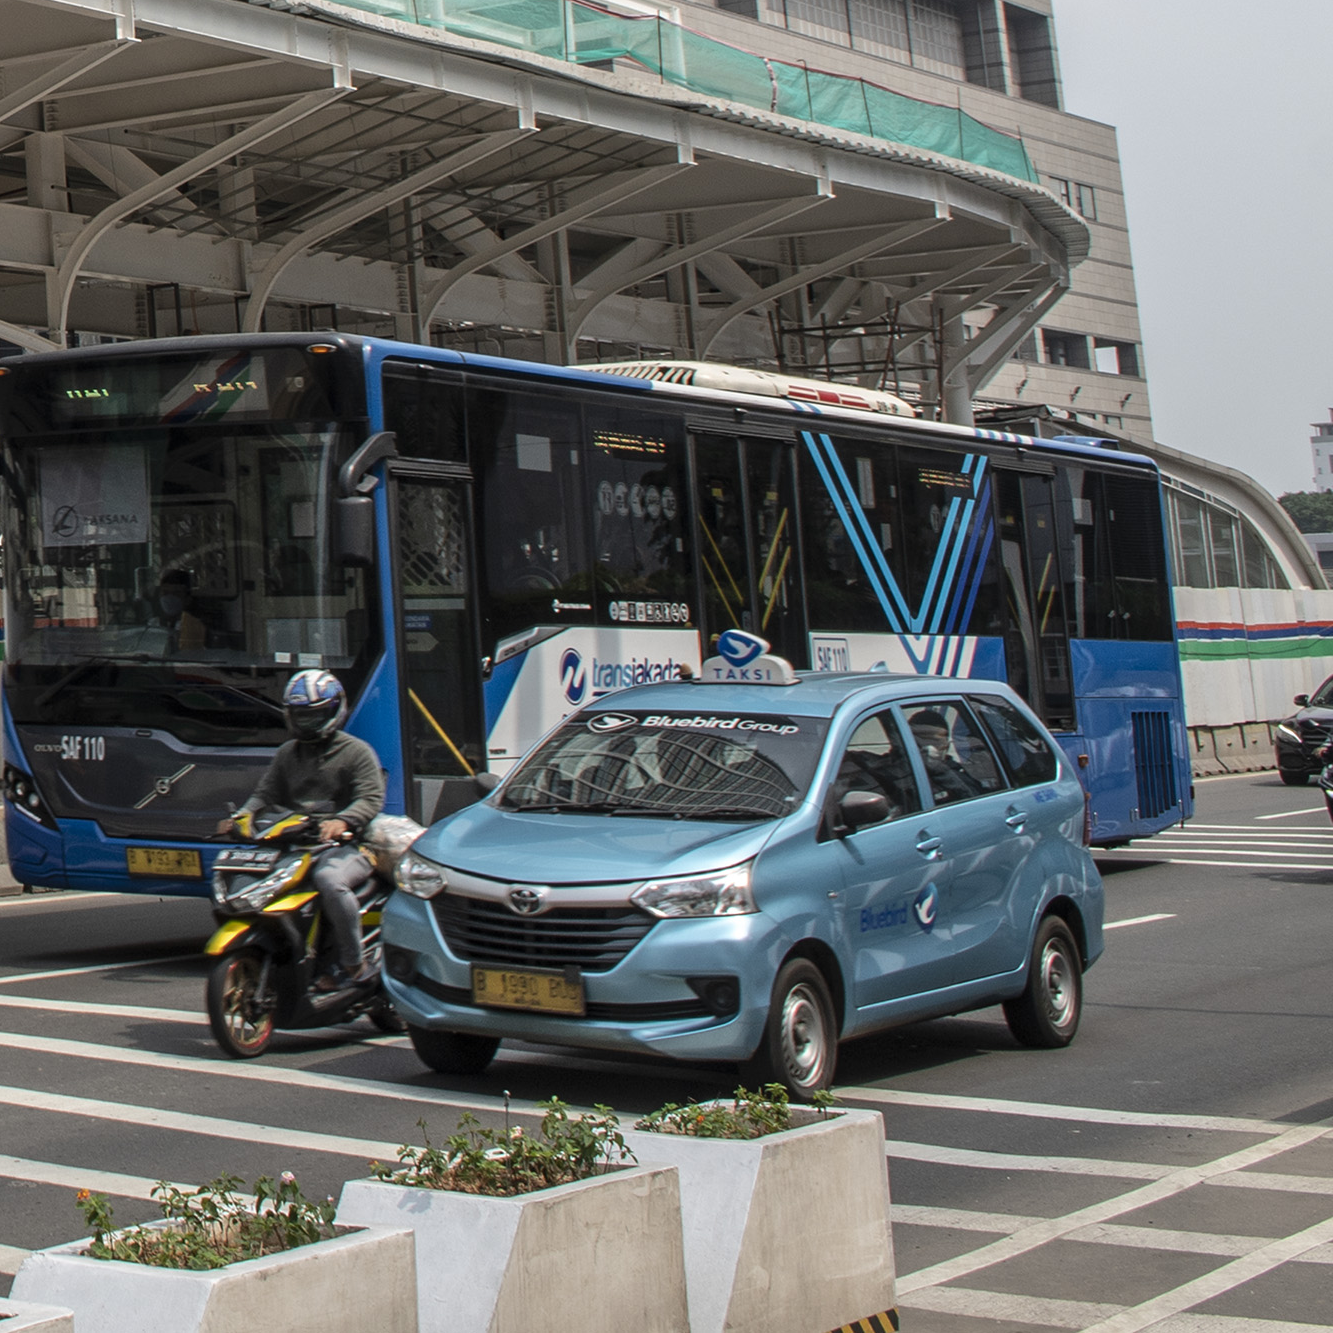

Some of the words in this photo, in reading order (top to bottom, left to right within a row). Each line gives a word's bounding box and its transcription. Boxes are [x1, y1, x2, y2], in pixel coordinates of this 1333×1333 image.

[713, 668, 771, 681] TAKSI
[61, 735, 82, 760] SAF
[83, 736, 106, 761] 110
[859, 904, 908, 933] Bluebird
[476, 970, 487, 991] B
